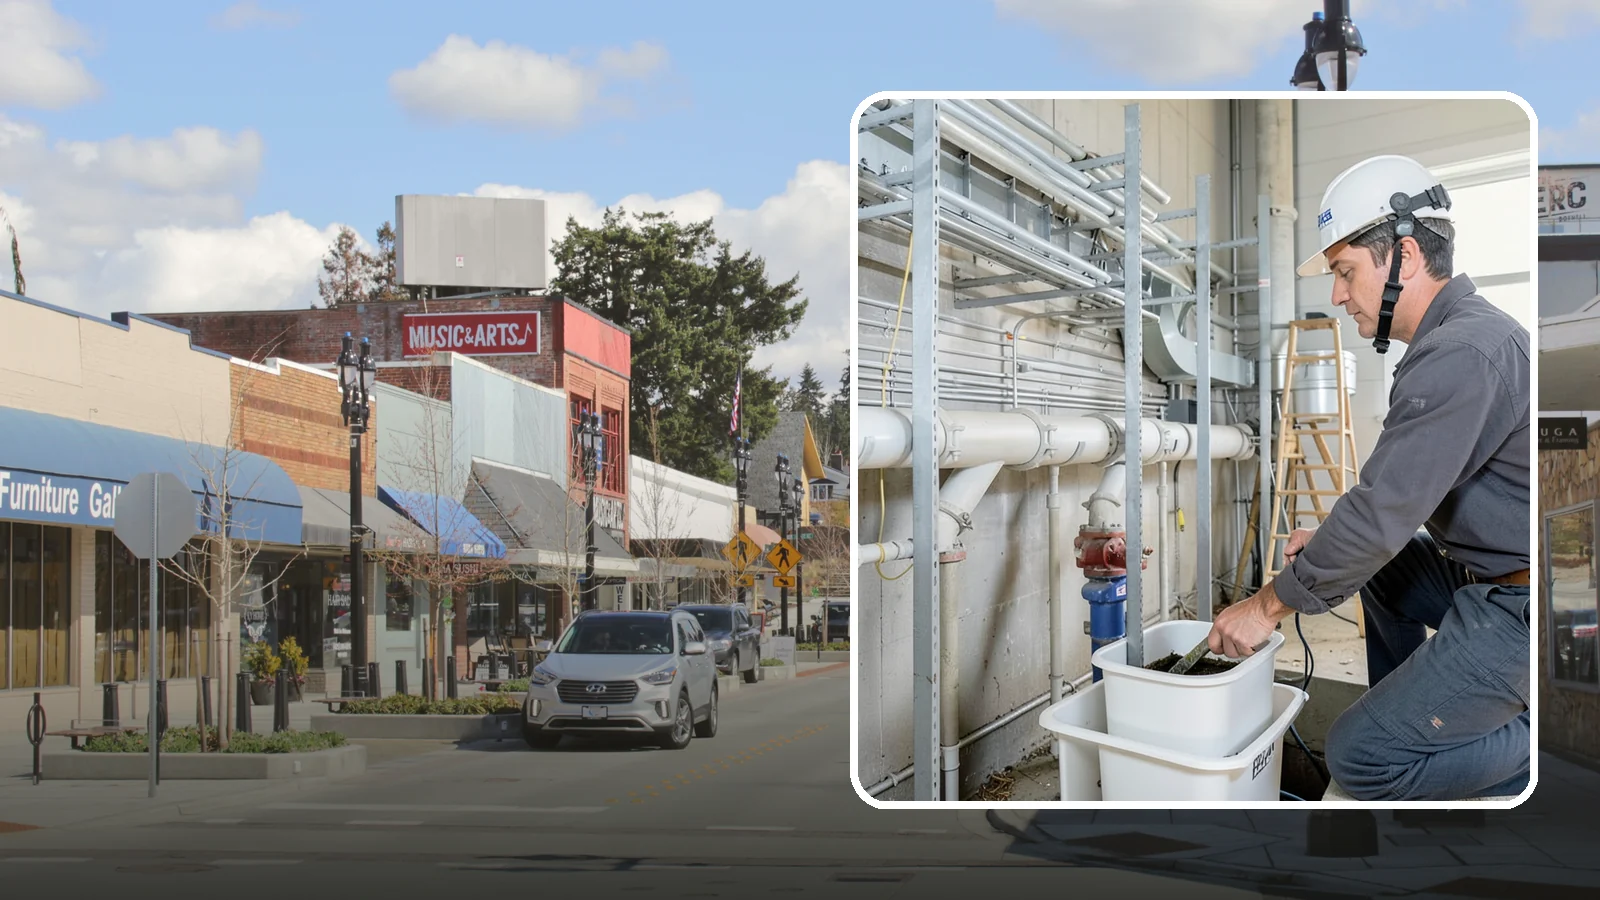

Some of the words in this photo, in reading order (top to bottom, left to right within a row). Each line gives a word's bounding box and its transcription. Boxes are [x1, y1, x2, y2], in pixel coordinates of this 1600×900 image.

[0, 471, 79, 516] Furniture
[89, 482, 122, 519] Gal
[453, 563, 479, 574] SUSHI
